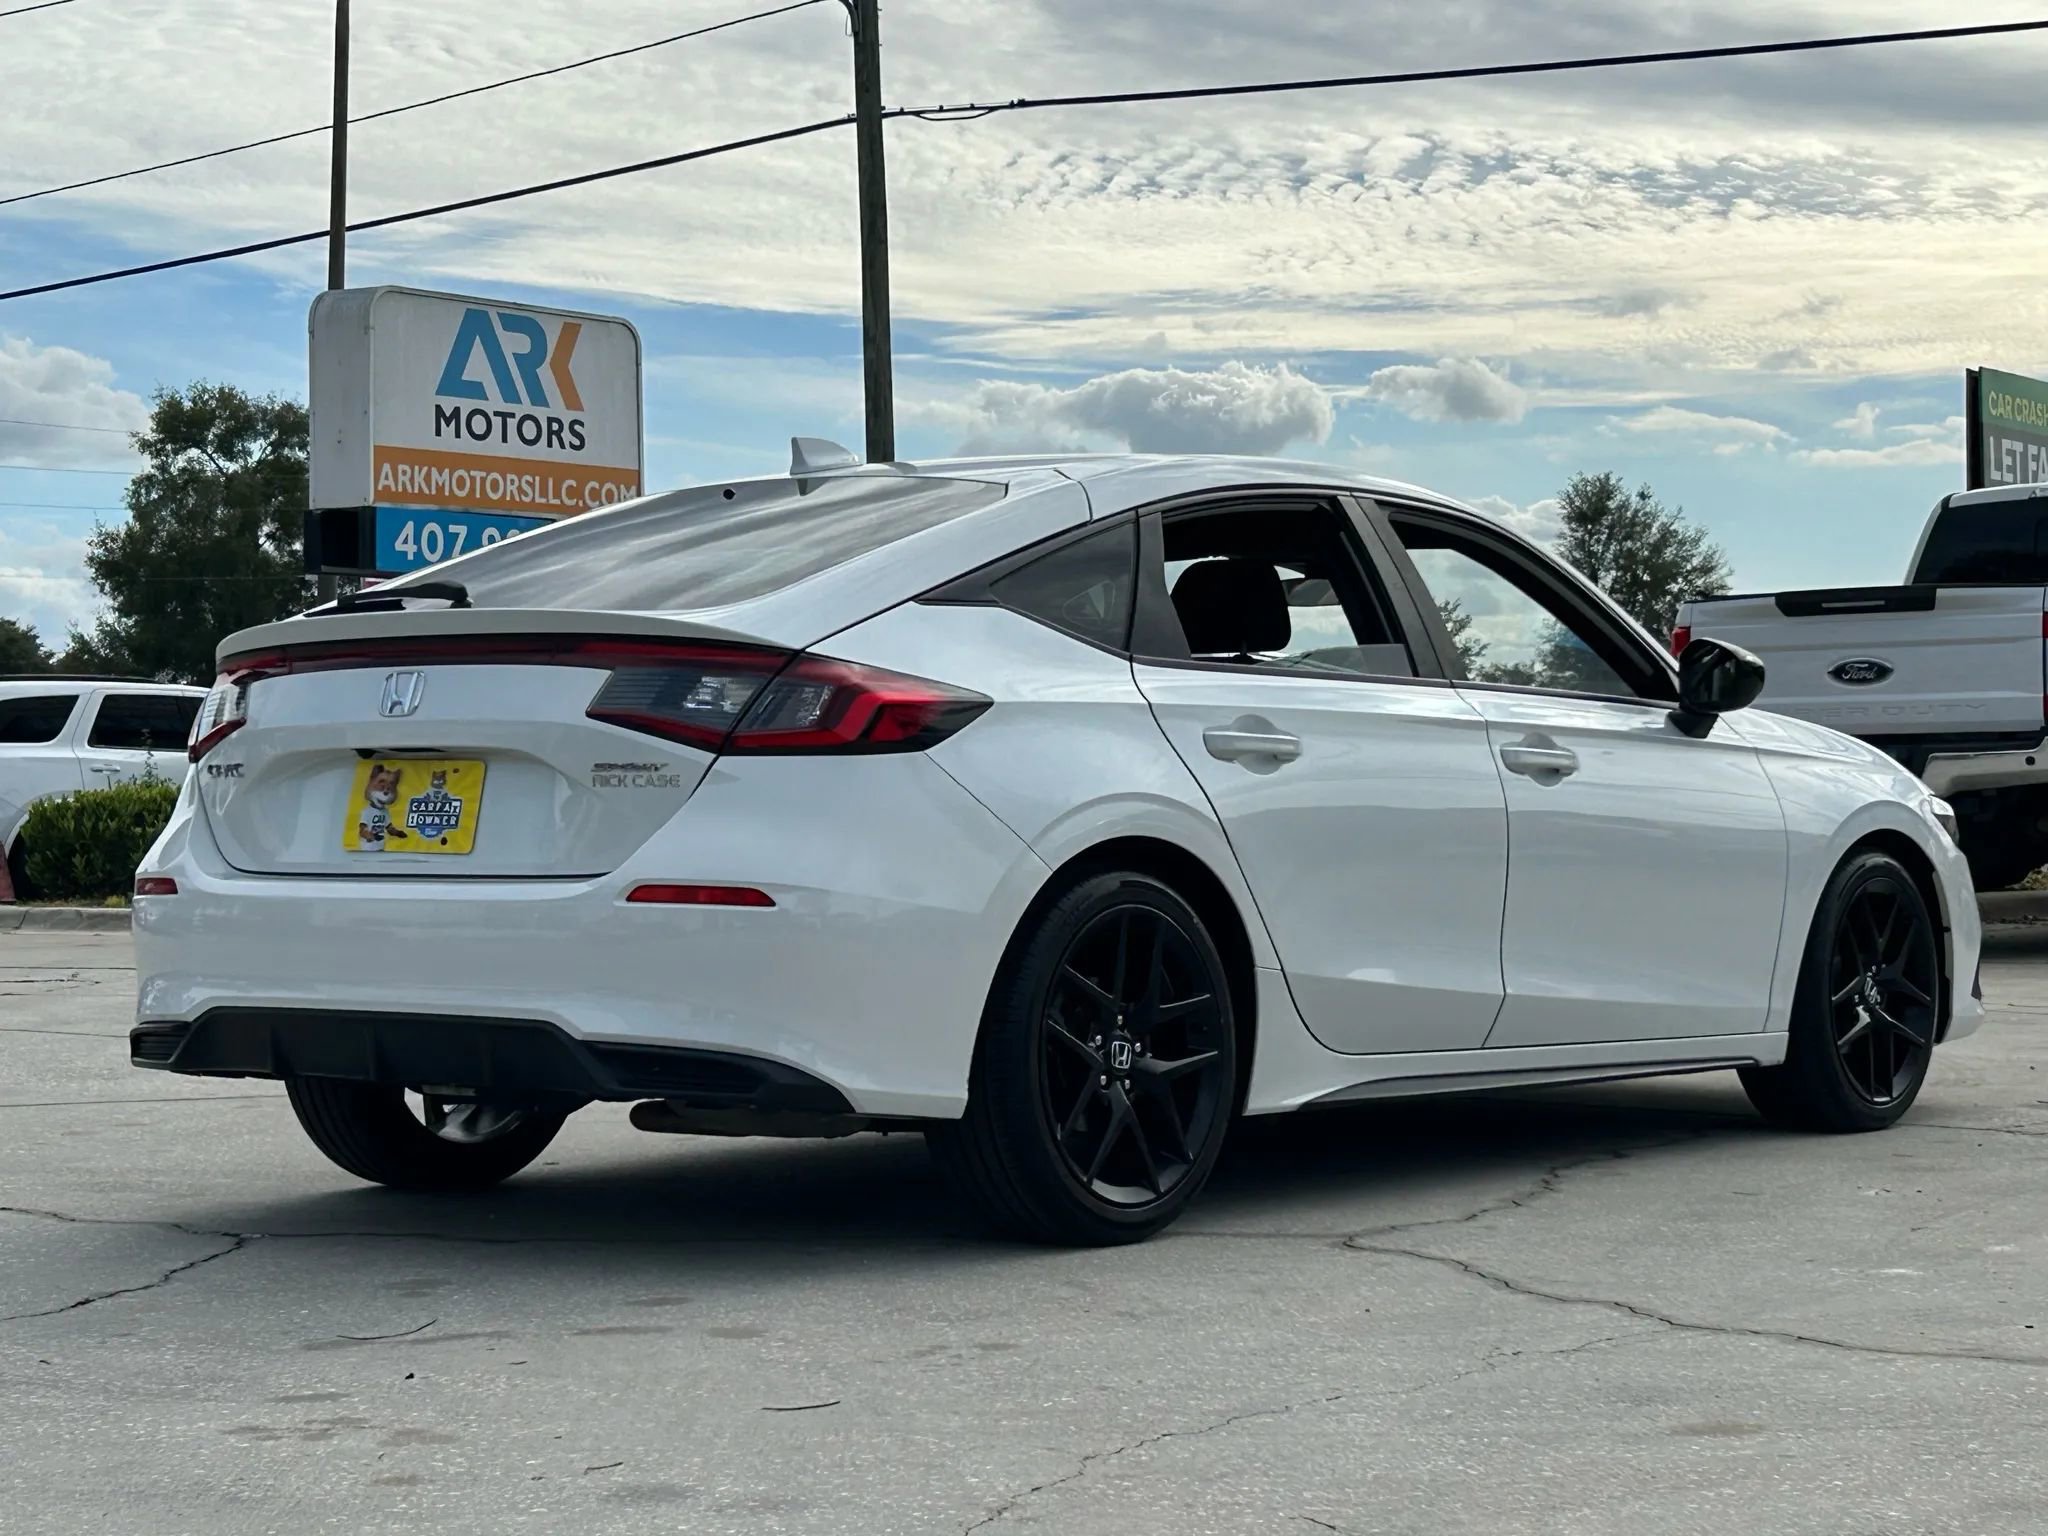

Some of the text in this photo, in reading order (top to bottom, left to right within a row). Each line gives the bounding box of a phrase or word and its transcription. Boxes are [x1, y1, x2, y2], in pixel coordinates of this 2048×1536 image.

[435, 307, 585, 412] ARK
[434, 403, 586, 451] MOTORS
[1988, 390, 2013, 419] CAR
[1989, 435, 2023, 485] LET
[377, 462, 638, 509] ARKMOTORSLLC.COM
[394, 520, 468, 564] 407
[1841, 663, 1878, 680] Ford
[411, 801, 461, 814] CARFAX
